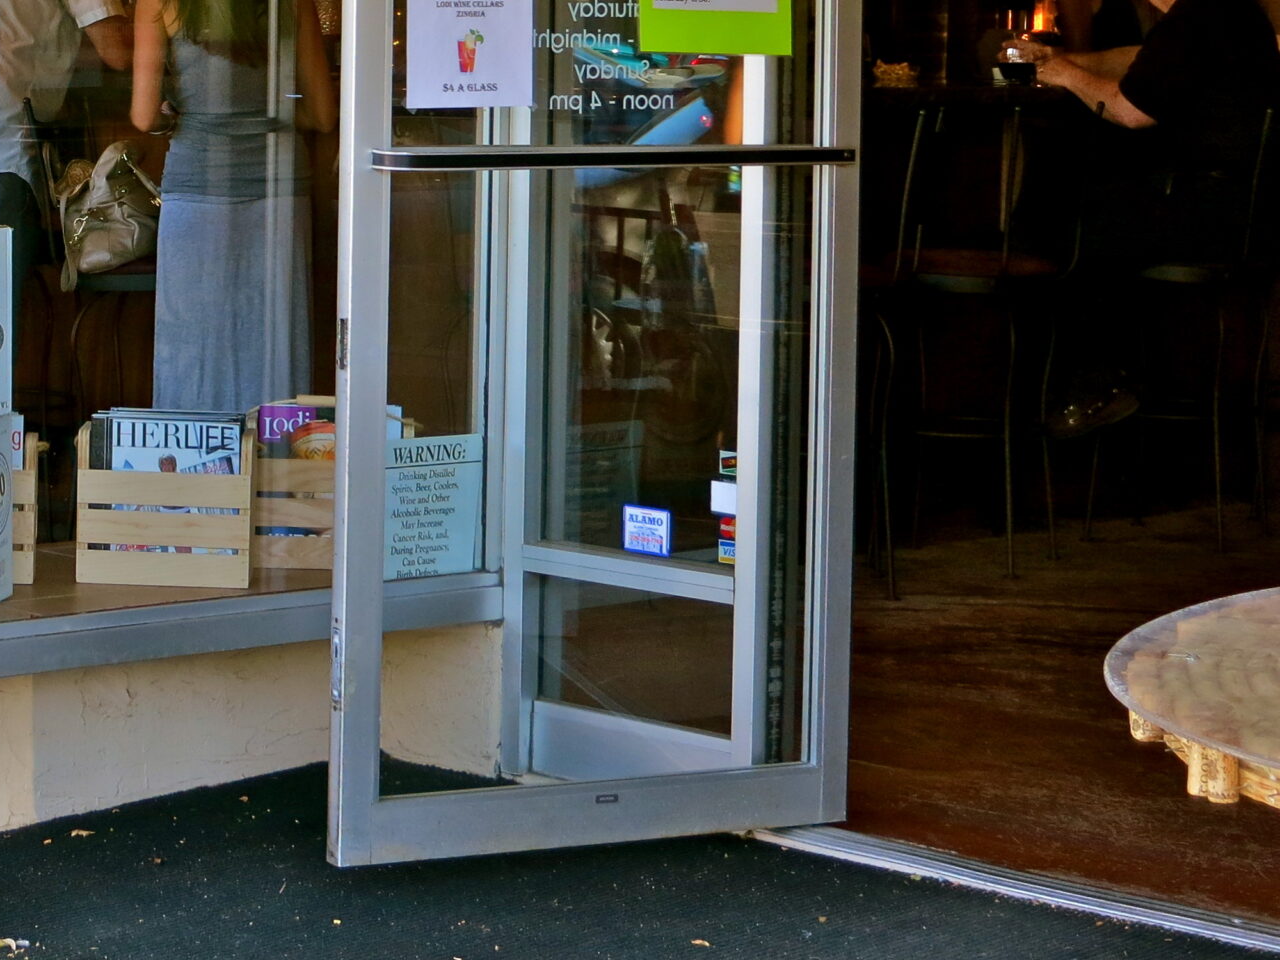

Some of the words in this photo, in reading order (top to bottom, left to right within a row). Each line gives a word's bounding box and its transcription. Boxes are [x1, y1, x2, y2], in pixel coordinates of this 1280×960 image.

[436, 0, 452, 8] LODI
[454, 0, 471, 8] WINE
[472, 0, 504, 8] CELLARS
[443, 83, 454, 93] $4
[457, 83, 464, 92] A
[467, 82, 498, 92] GLASS
[393, 442, 466, 465] WARNING:
[398, 471, 428, 482] Drinking
[428, 467, 456, 478] Distilled
[415, 483, 431, 493] Beer,
[399, 496, 416, 505] Wine
[417, 495, 430, 504] and
[431, 493, 450, 503] Other
[390, 507, 422, 519] Alcoholic
[423, 506, 456, 517] Beverages
[400, 520, 416, 530] May
[417, 519, 444, 529] Increase
[628, 513, 664, 527] ALAMO
[392, 534, 416, 544] Cancer
[417, 531, 434, 541] Risk,
[390, 546, 414, 557] During
[414, 543, 450, 554] Pregnancy,
[722, 546, 735, 558] VIS
[402, 556, 416, 567] Can
[417, 555, 437, 566] Cause
[396, 569, 414, 579] Birth
